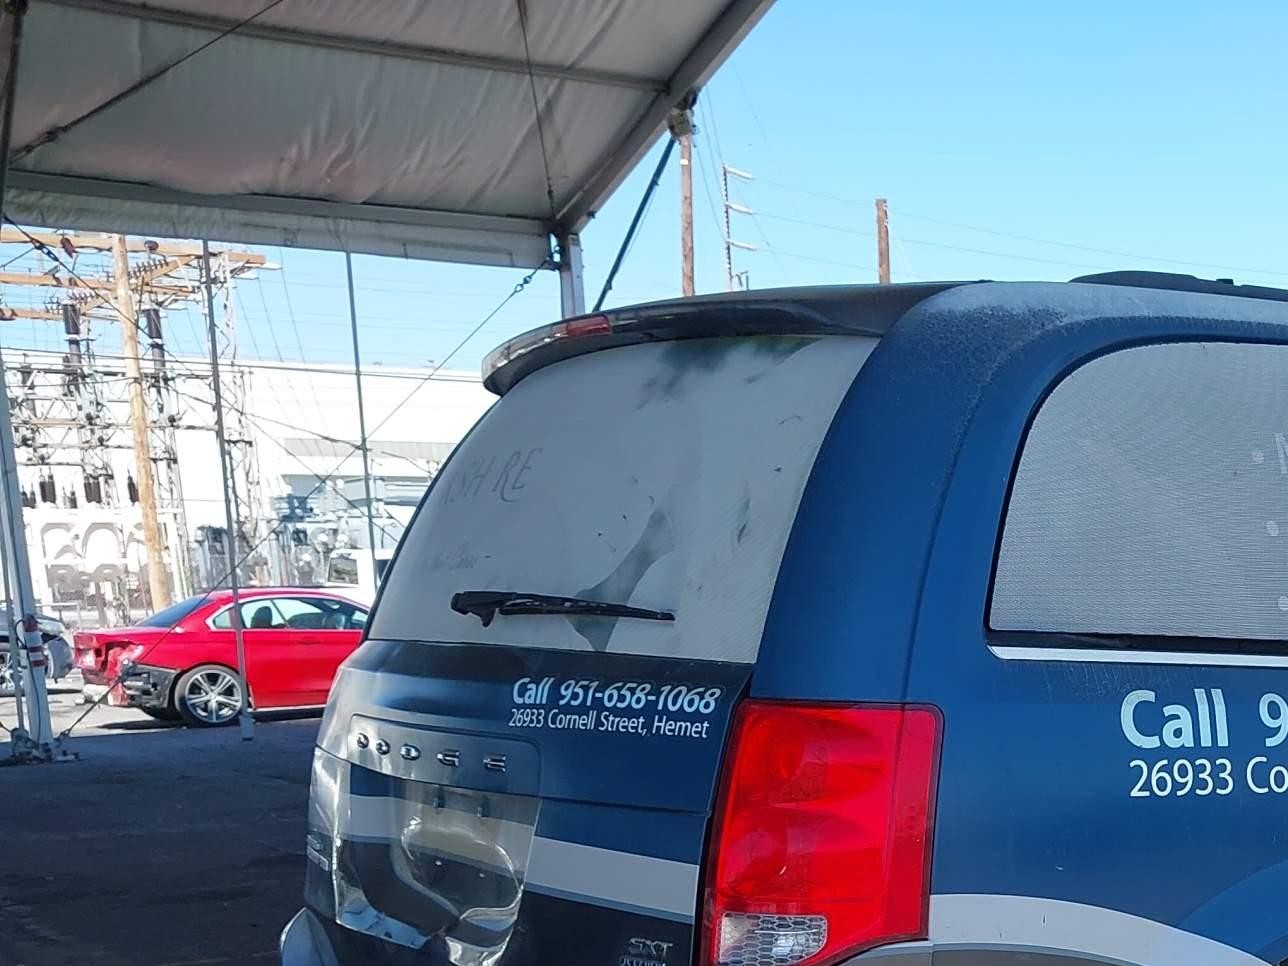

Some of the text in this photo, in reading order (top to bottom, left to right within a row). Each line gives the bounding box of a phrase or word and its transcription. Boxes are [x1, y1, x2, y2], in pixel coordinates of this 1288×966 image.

[512, 677, 722, 714] Call 951-658-1068
[508, 708, 710, 738] 26933 Cornell Street, Hemet
[1120, 688, 1230, 749] Call
[1129, 758, 1235, 798] 26933
